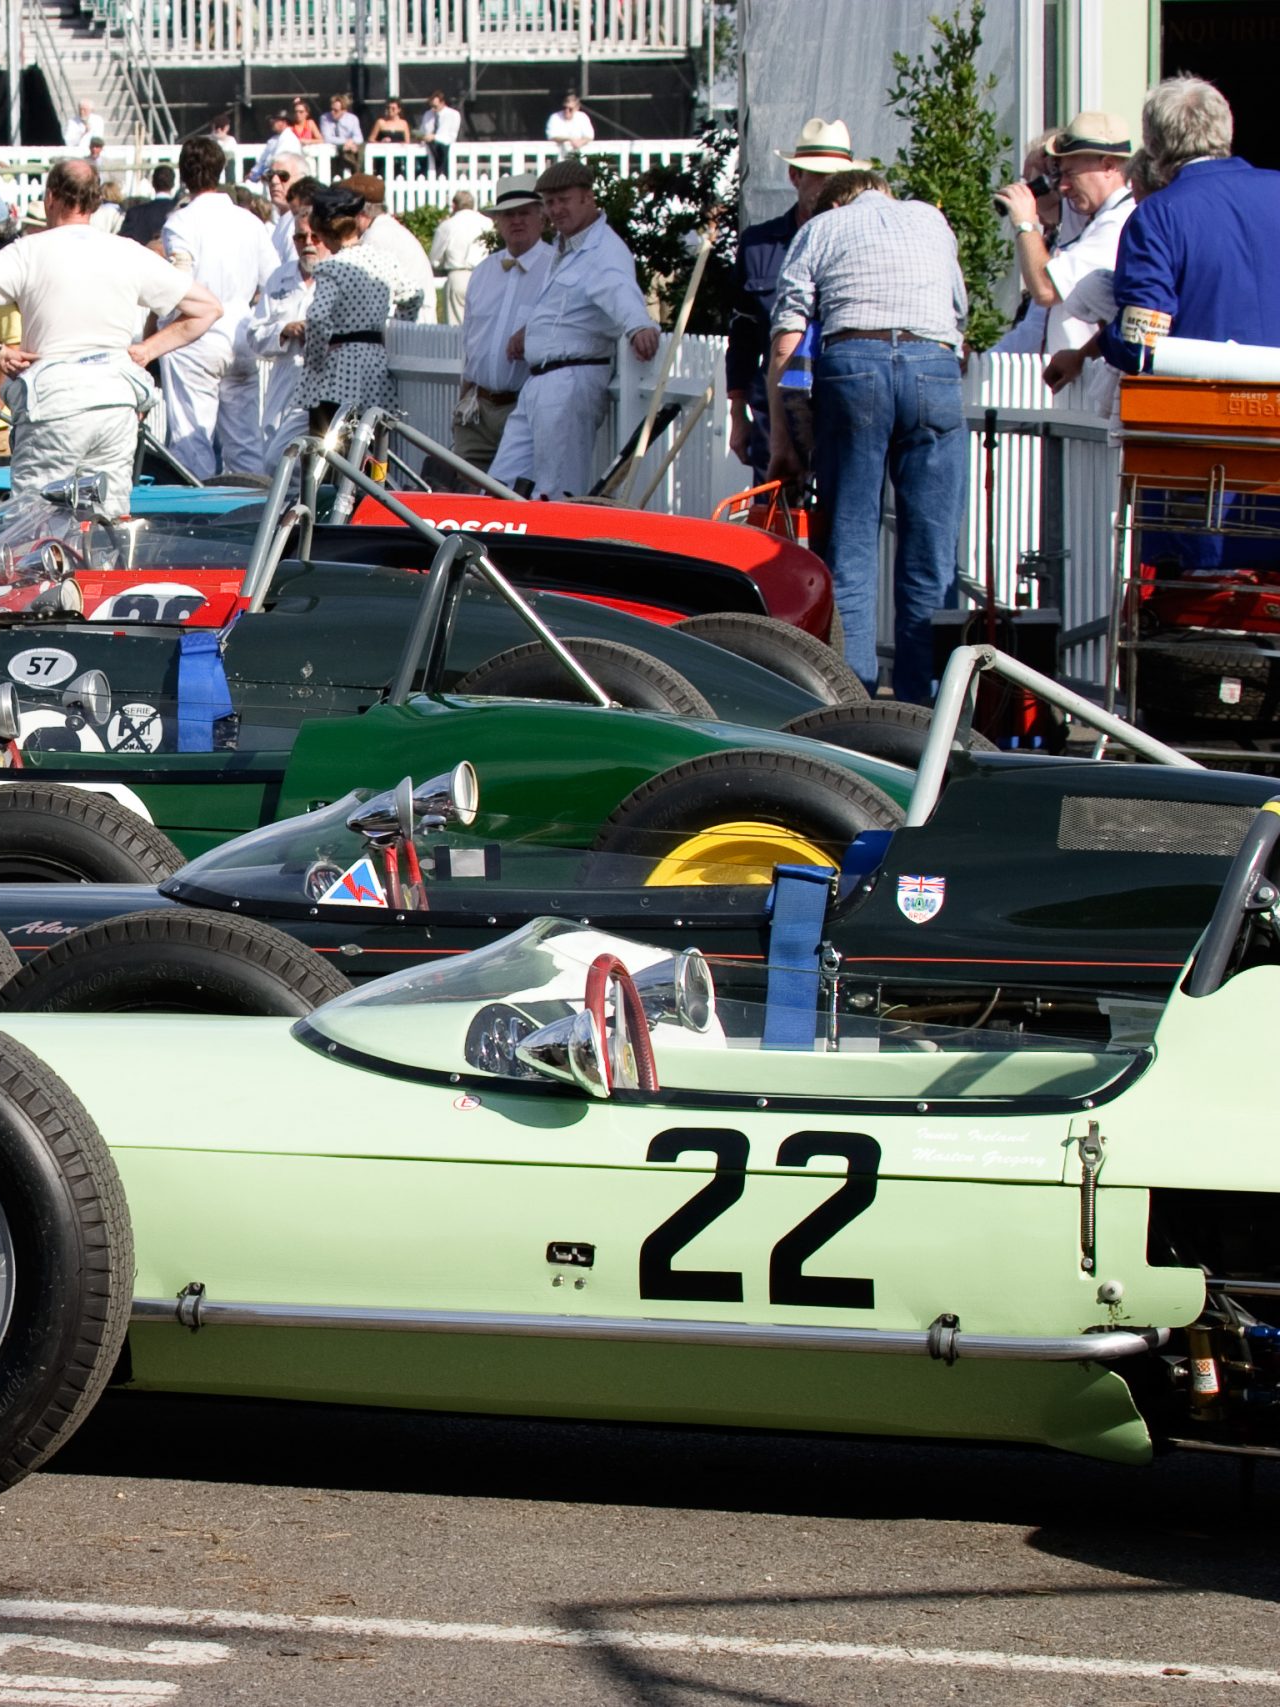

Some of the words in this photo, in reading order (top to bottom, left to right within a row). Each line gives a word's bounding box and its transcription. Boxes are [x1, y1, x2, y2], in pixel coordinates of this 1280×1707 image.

[1168, 15, 1280, 47] NQUIRIE
[422, 518, 528, 536] OSCH
[26, 656, 59, 676] 57
[124, 706, 152, 715] SERIE
[7, 920, 79, 936] Alan
[916, 1126, 960, 1141] Innes
[967, 1128, 1031, 1143] Ireland
[912, 1147, 977, 1162] Masten
[981, 1149, 1047, 1167] Gregory
[638, 1126, 883, 1309] 22
